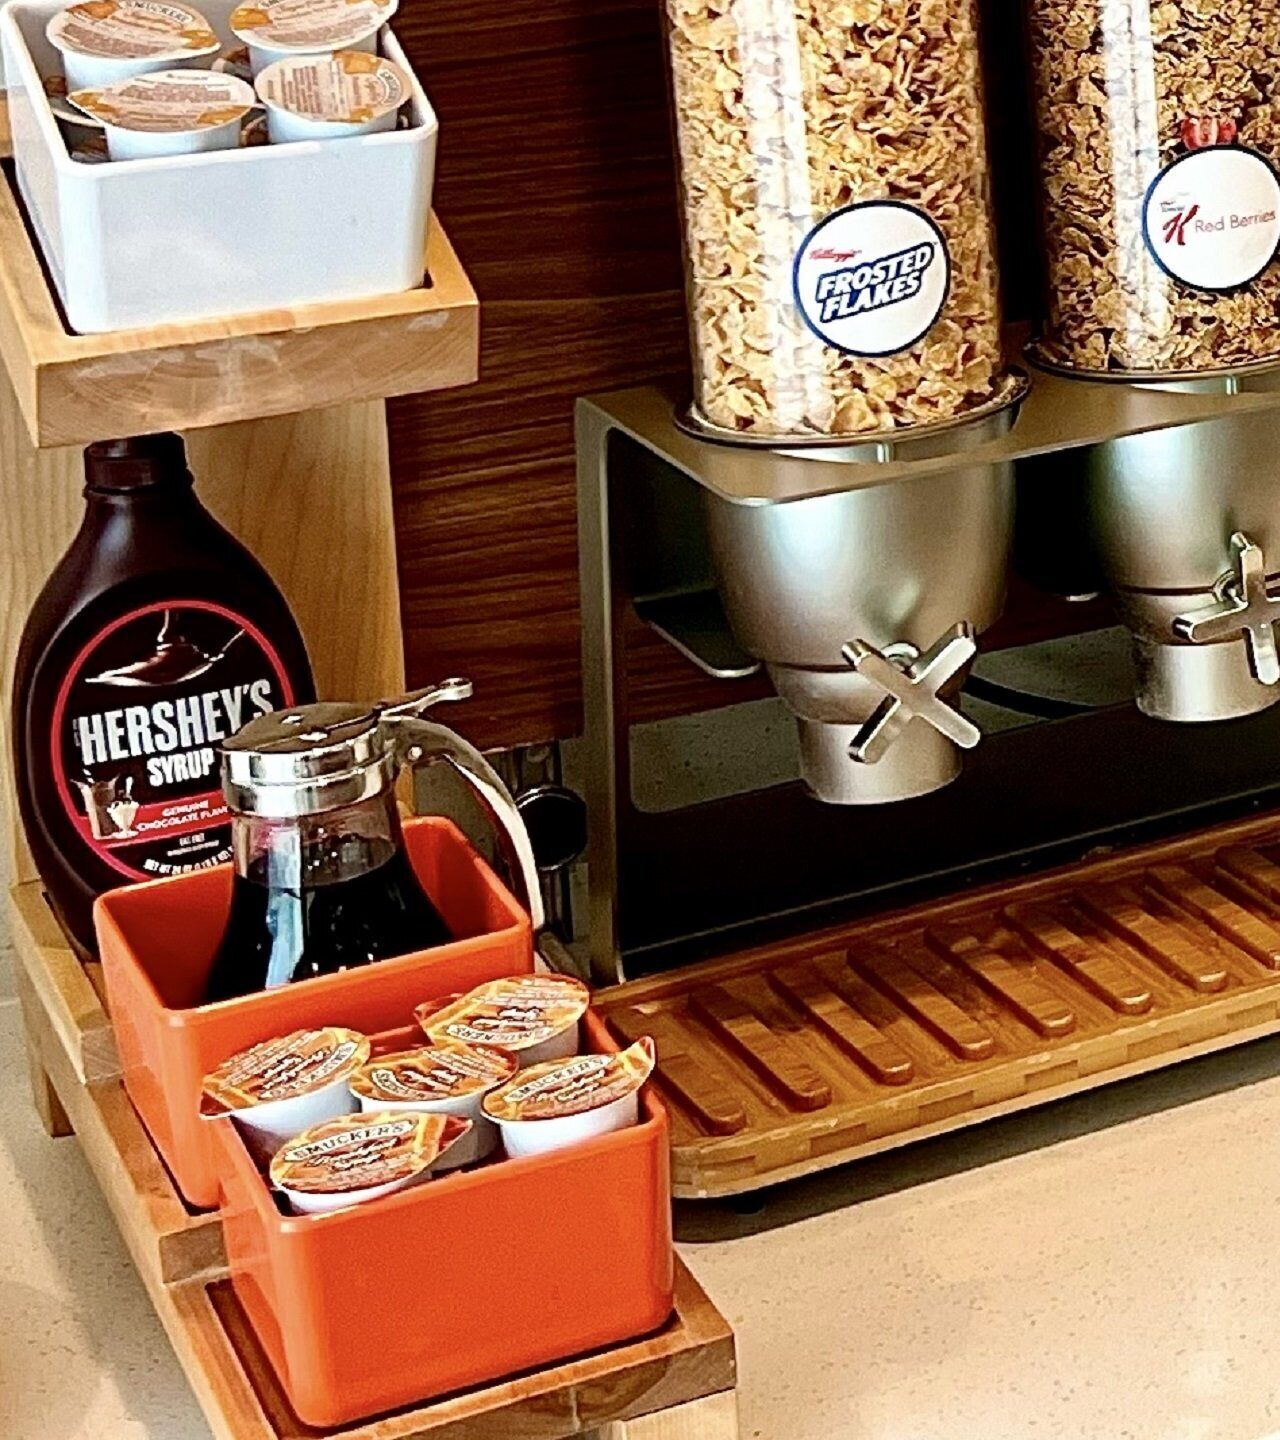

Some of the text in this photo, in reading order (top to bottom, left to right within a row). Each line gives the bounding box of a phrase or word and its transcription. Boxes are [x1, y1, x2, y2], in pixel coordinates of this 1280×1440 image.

[1194, 215, 1226, 234] Red
[1229, 209, 1277, 229] Berries
[817, 244, 934, 302] FROSTED
[821, 270, 922, 322] FLAKES
[78, 678, 274, 766] HERSHEY'S
[146, 747, 215, 787] SYRUP
